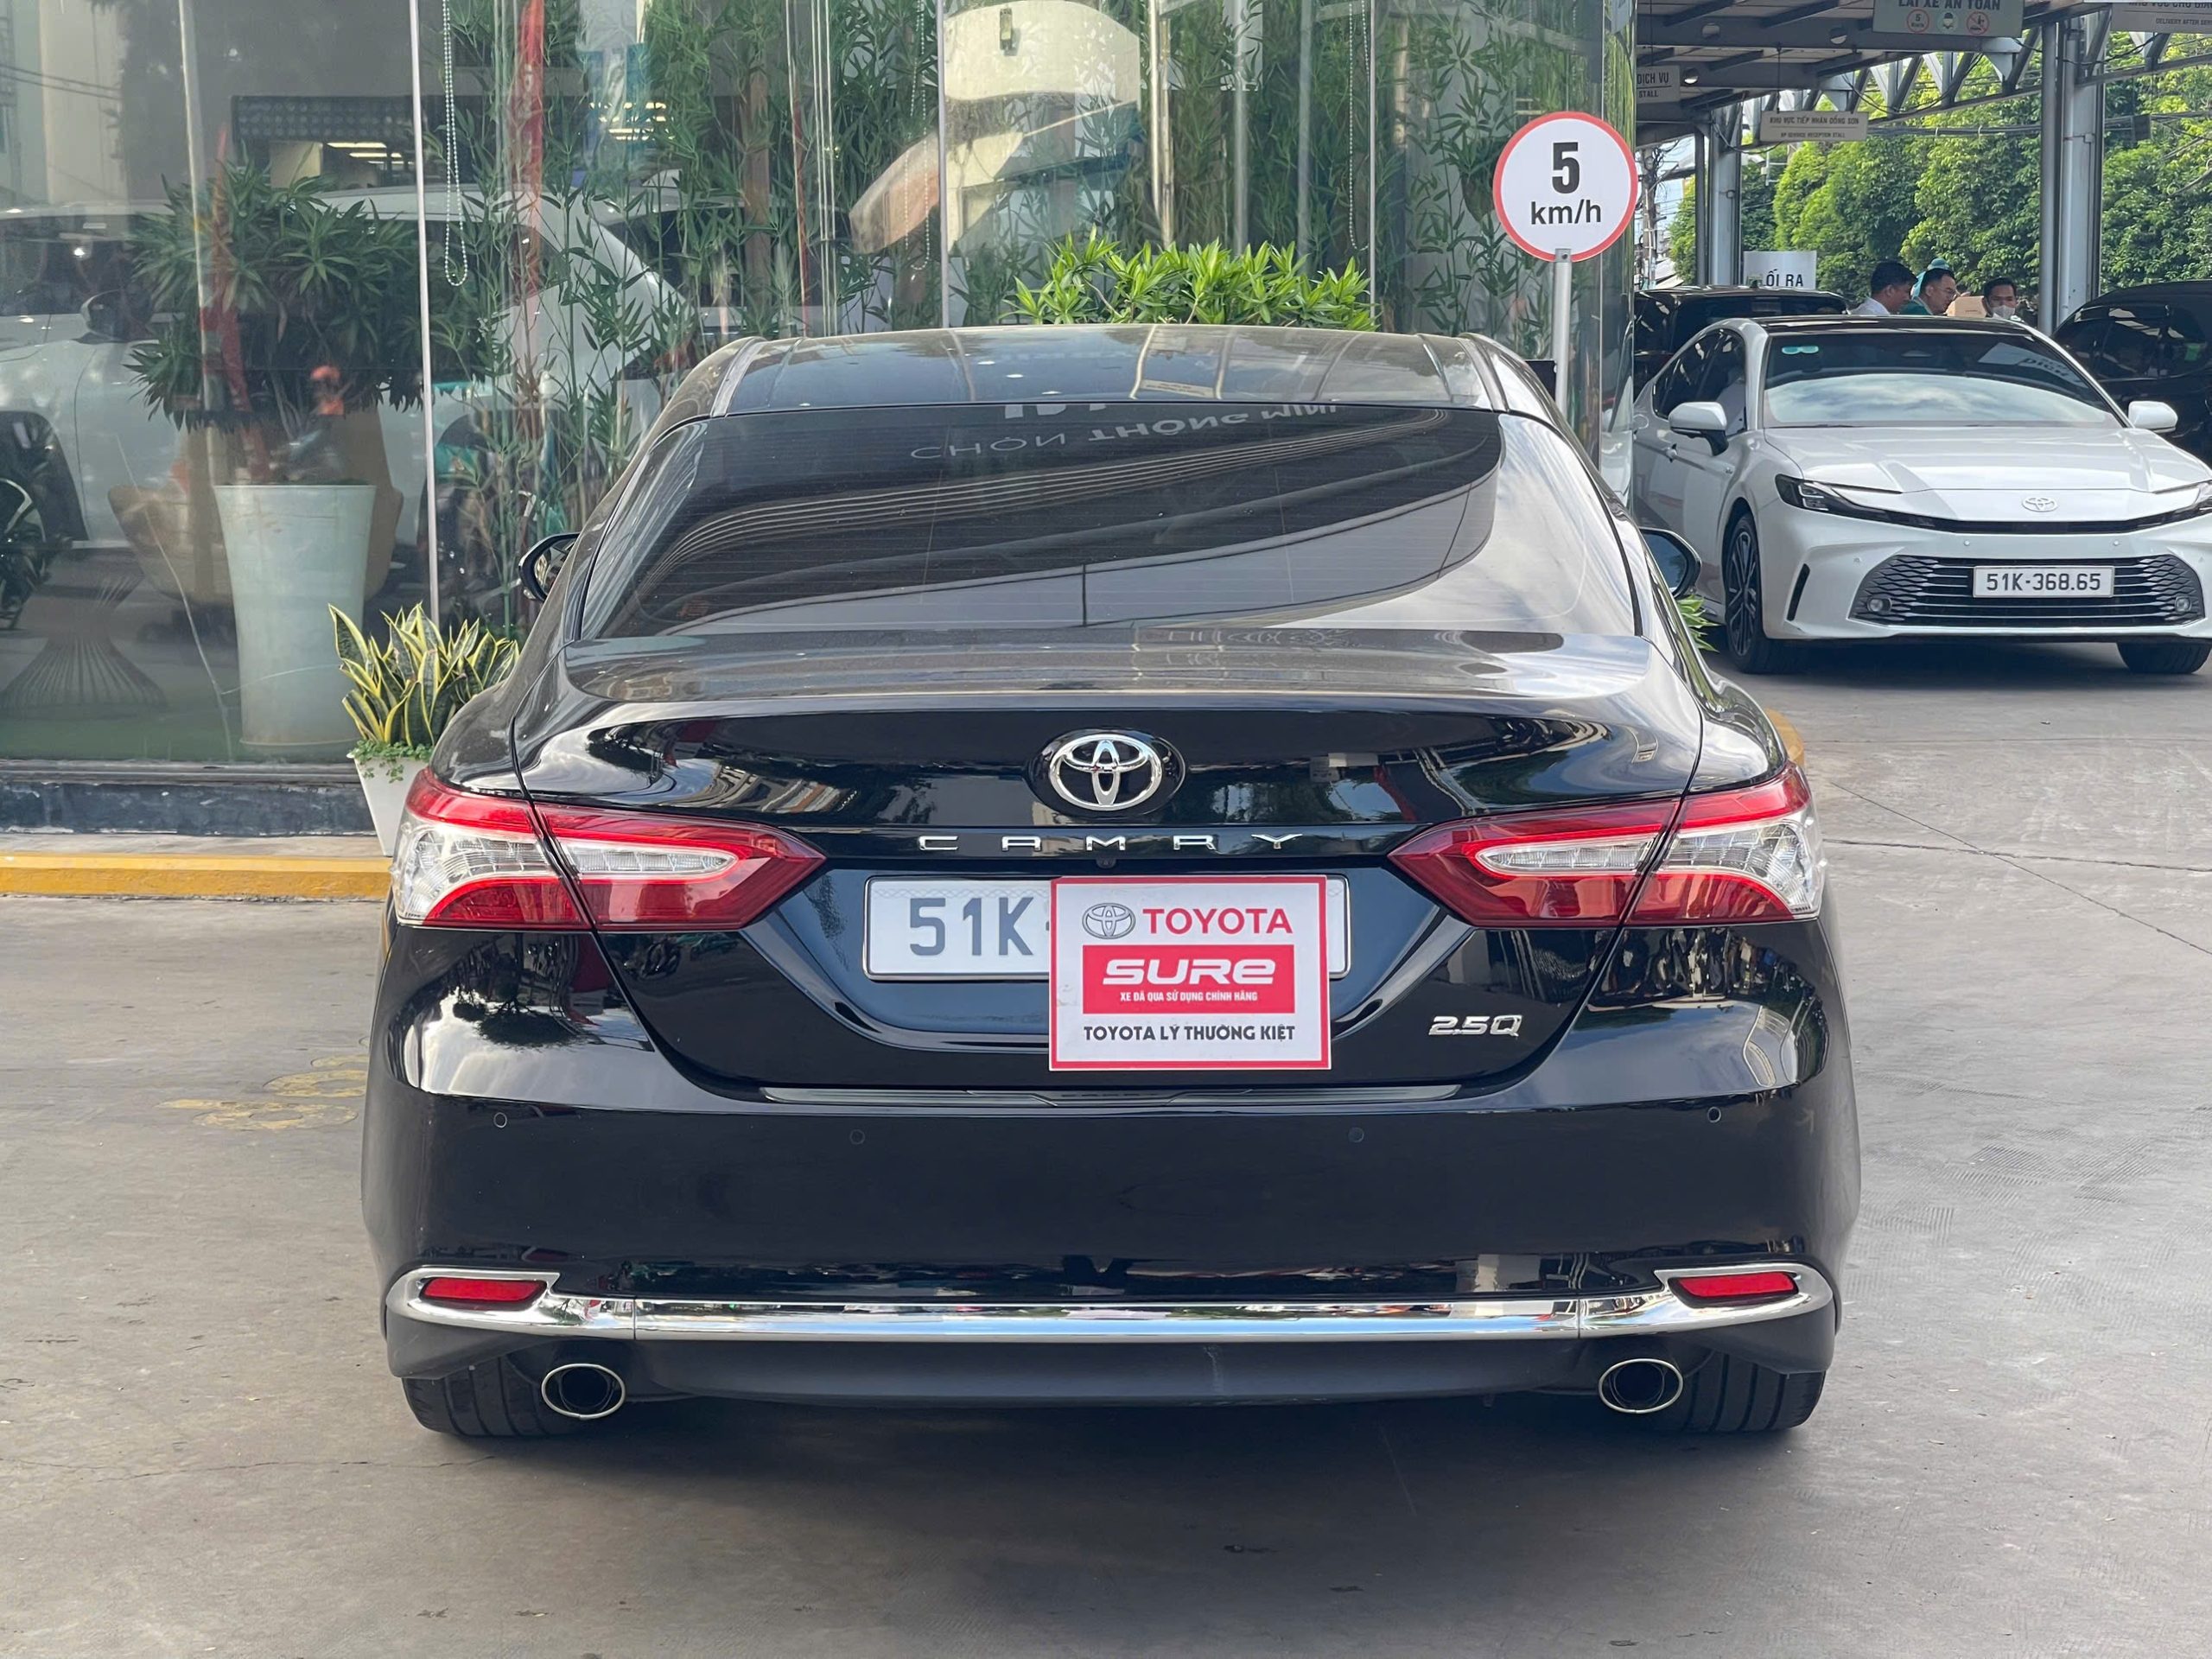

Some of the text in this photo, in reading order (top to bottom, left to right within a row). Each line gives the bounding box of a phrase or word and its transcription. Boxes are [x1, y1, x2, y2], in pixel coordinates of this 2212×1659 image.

[1552, 142, 1580, 194] 5
[1530, 199, 1602, 226] km/h
[1785, 274, 1804, 287] RA
[1986, 572, 2101, 592] 51K-368.65
[918, 832, 1303, 852] CAMRY
[910, 896, 1049, 957] 51K
[1141, 907, 1294, 935] TOYOTA
[1120, 991, 1131, 1001] XE
[1133, 989, 1146, 1001] ĐÃ
[1147, 991, 1165, 1002] QUA
[1179, 991, 1204, 1004] DỤNG
[1205, 989, 1232, 1001] CHÍNH
[1084, 1023, 1295, 1042] TOYOTA LÝ THƯỜNG KIỆT
